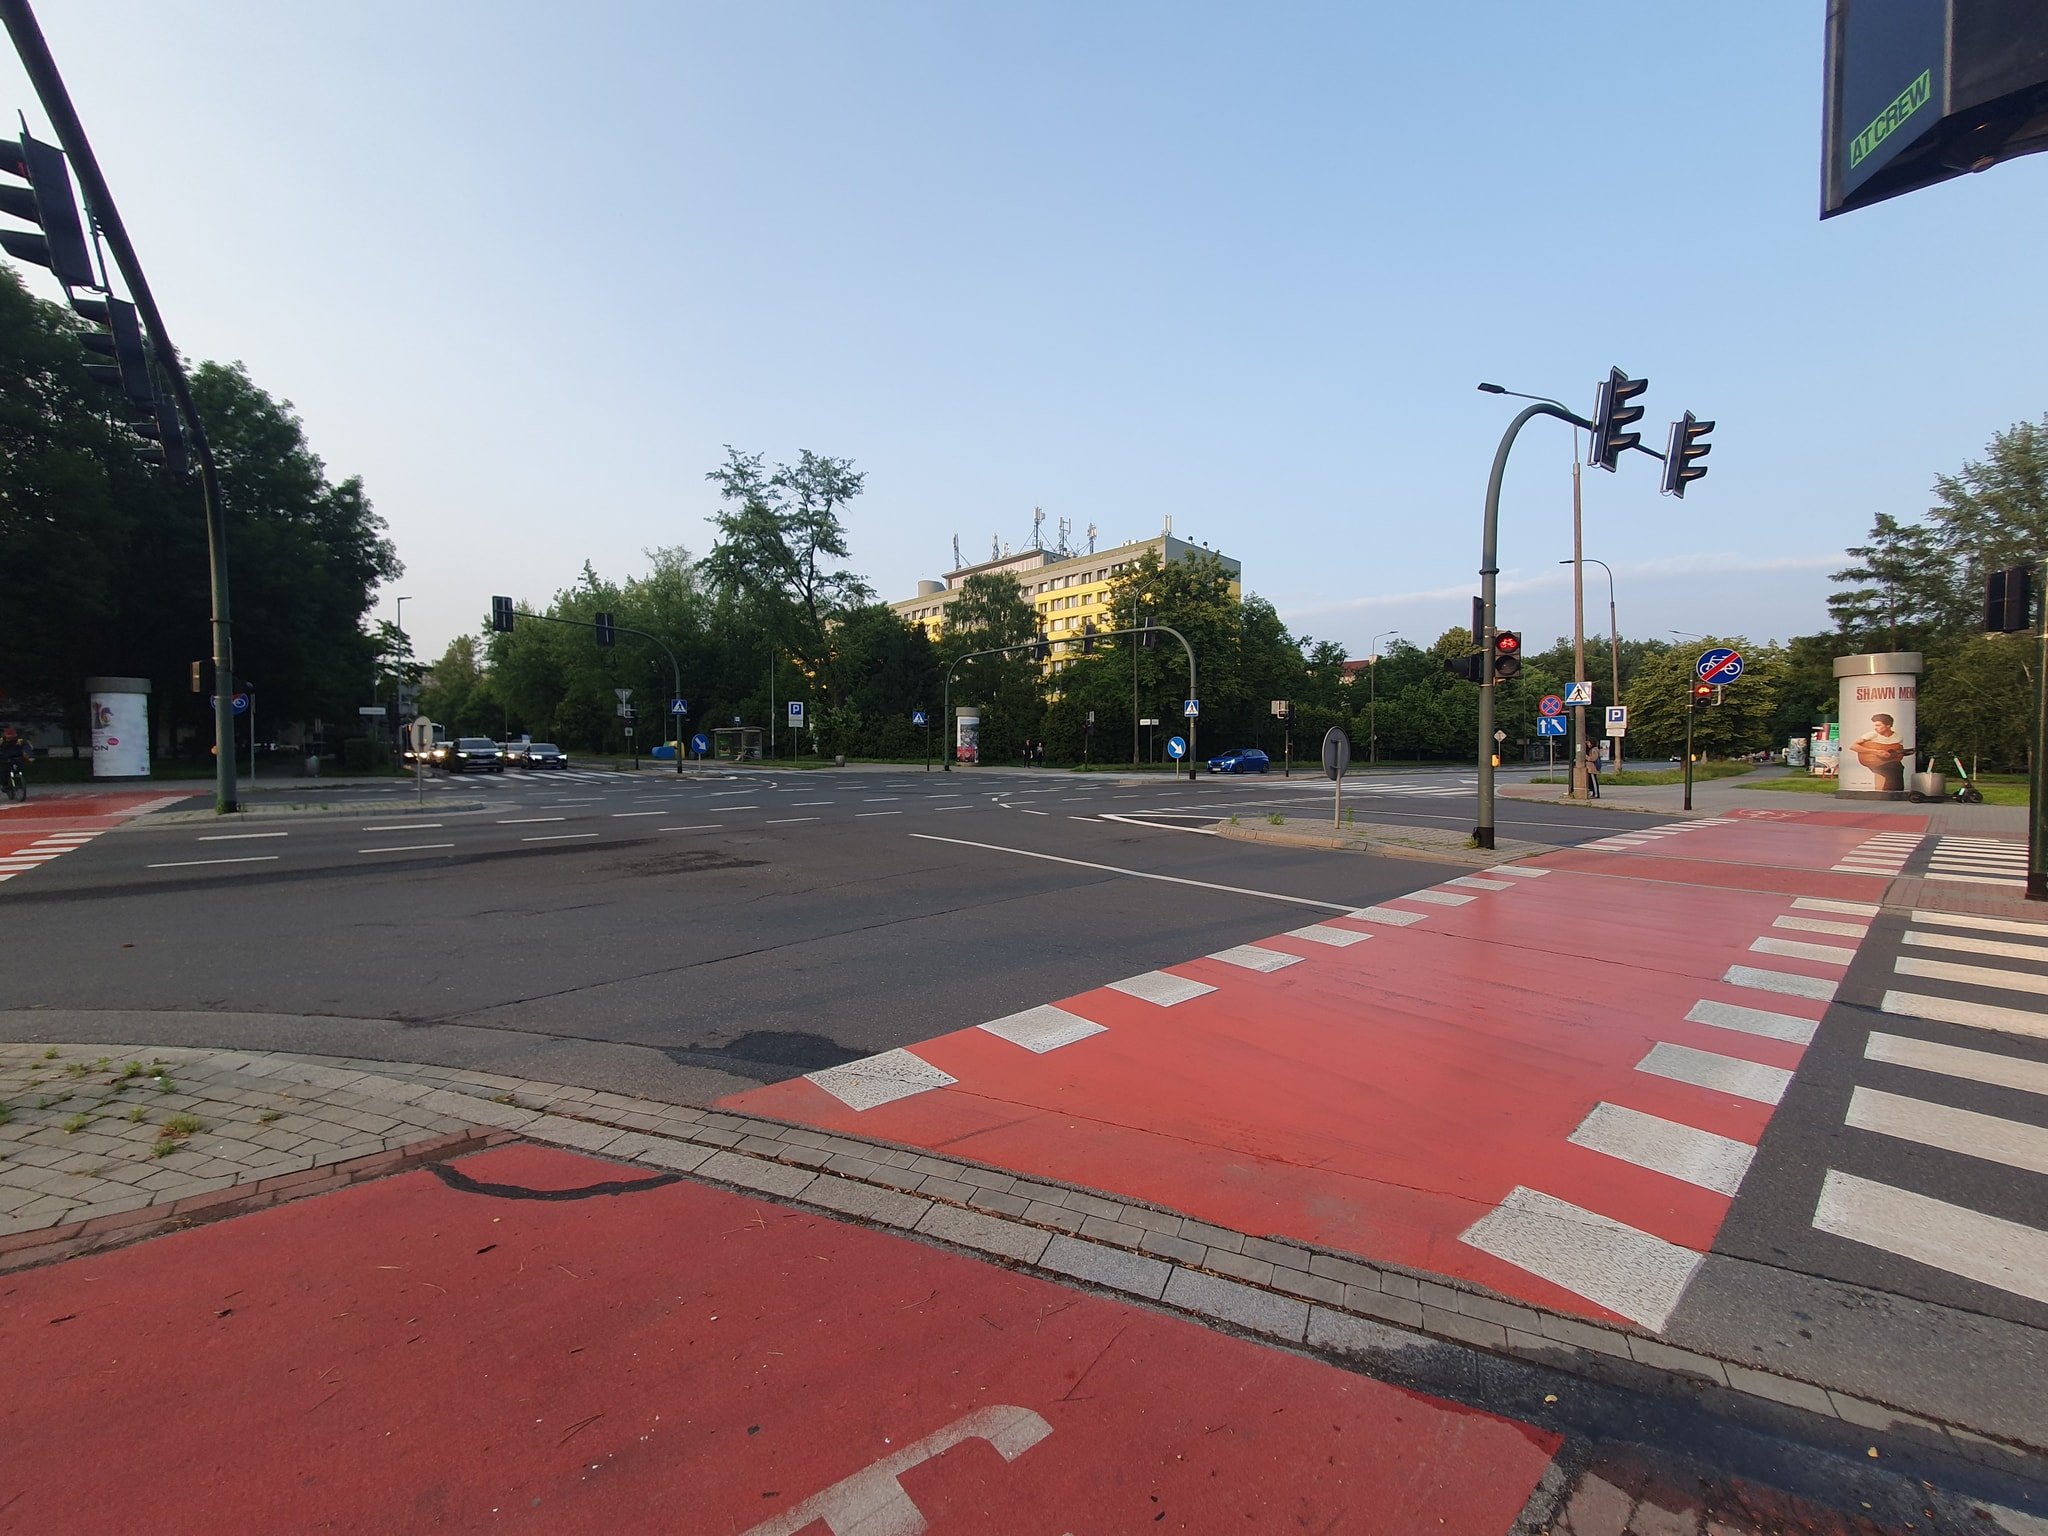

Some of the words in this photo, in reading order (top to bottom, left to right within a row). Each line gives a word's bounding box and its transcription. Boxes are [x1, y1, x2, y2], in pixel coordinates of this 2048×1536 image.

[1852, 127, 1872, 166] AT
[1874, 73, 1928, 143] CREW
[1856, 687, 1896, 701] SHAWN
[793, 704, 800, 714] P
[1612, 710, 1621, 721] P
